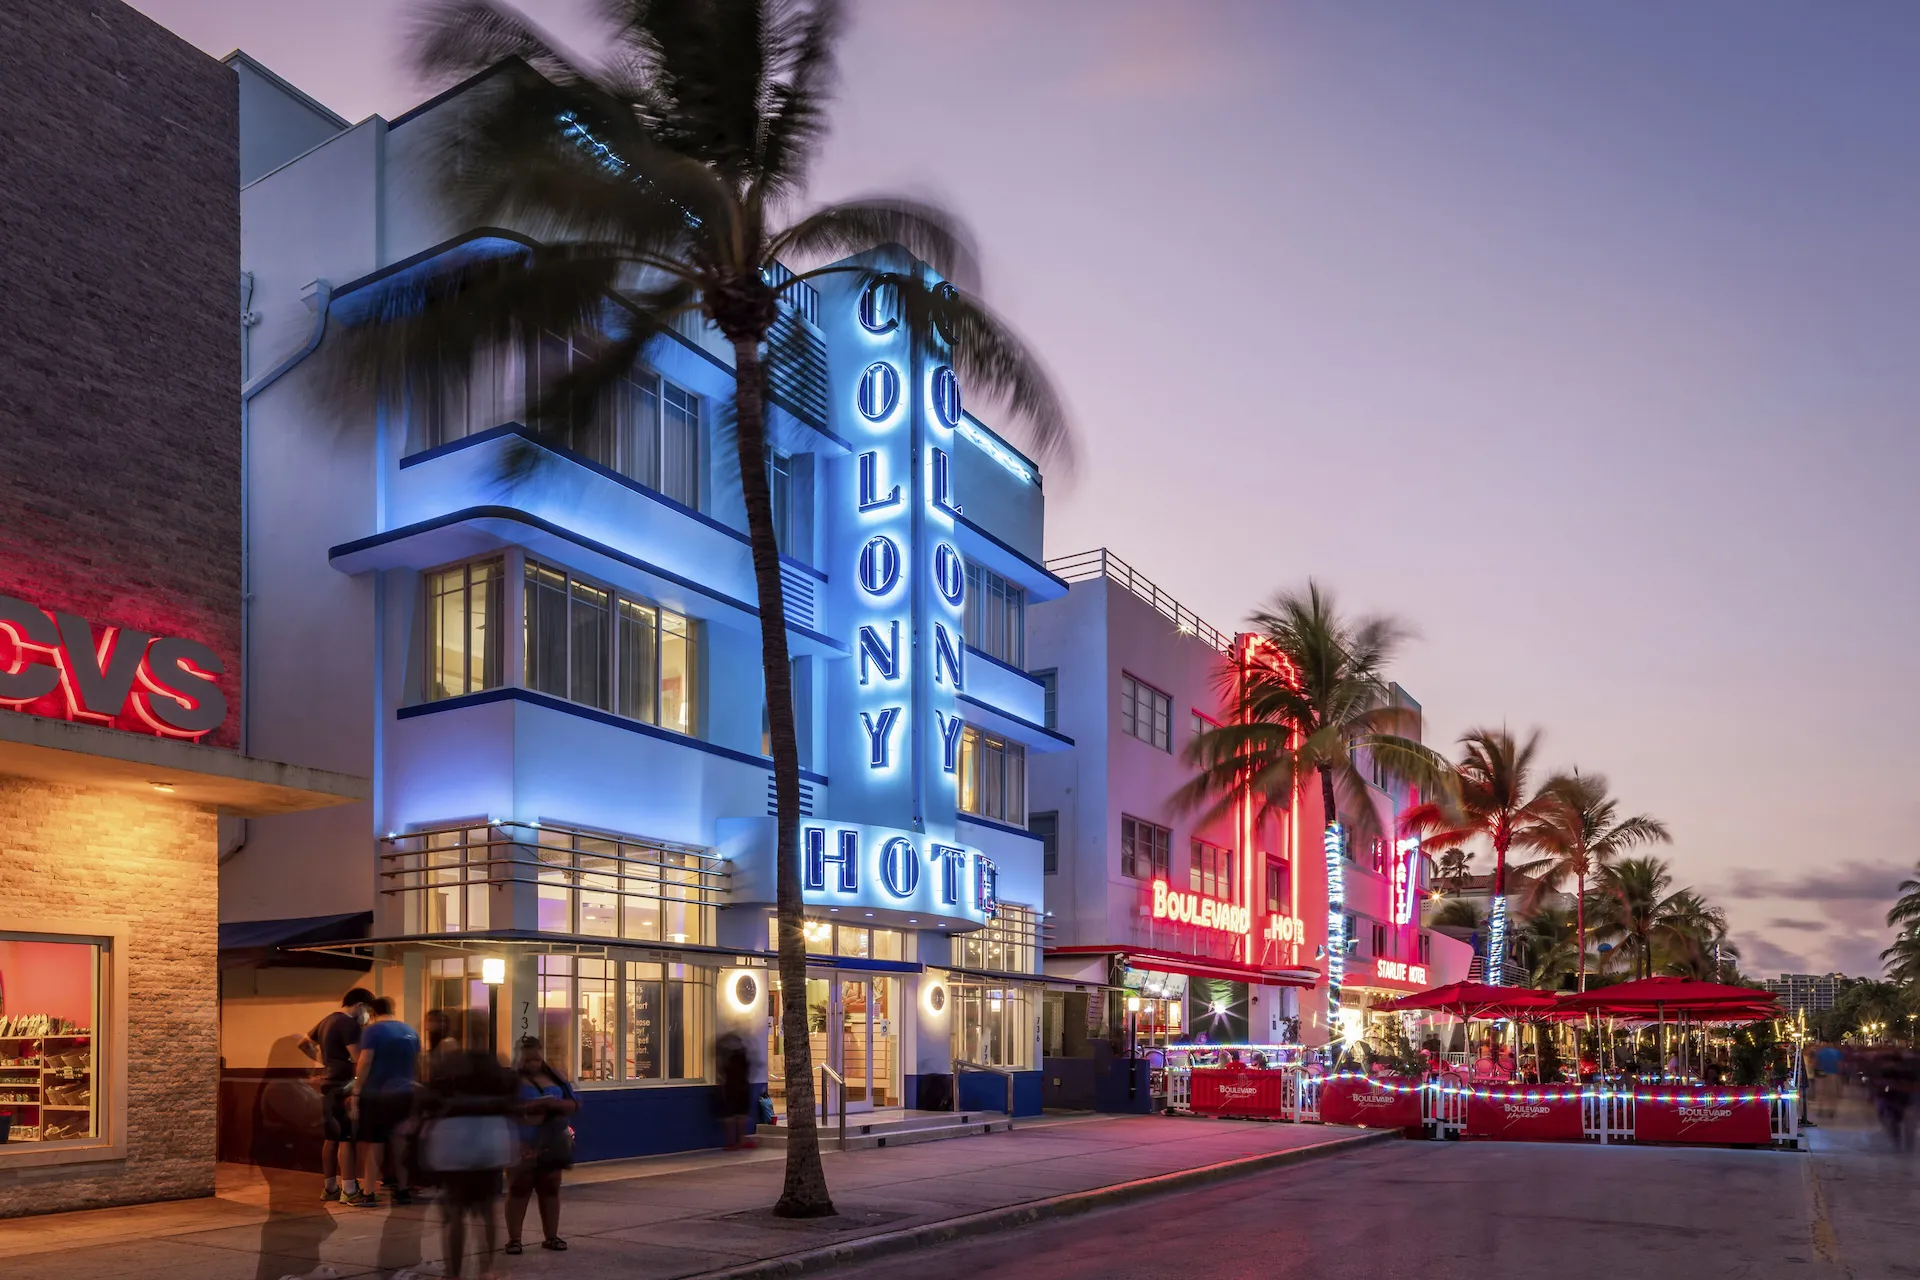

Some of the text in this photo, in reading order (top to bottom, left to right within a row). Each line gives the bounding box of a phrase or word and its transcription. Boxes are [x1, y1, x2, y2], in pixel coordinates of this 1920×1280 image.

[858, 272, 901, 769] COLONY
[931, 281, 965, 775] COLONY
[0, 595, 228, 732] CVS
[804, 827, 997, 919] HOTE
[1153, 879, 1250, 934] BOULEVARD
[1377, 959, 1427, 985] STARLITE HOTEL
[1219, 1085, 1257, 1095] BOULEVARD
[1352, 1093, 1395, 1103] BOULEVARD
[1504, 1104, 1550, 1113] BOULEVARD
[1678, 1107, 1732, 1116] BOULEVARD
